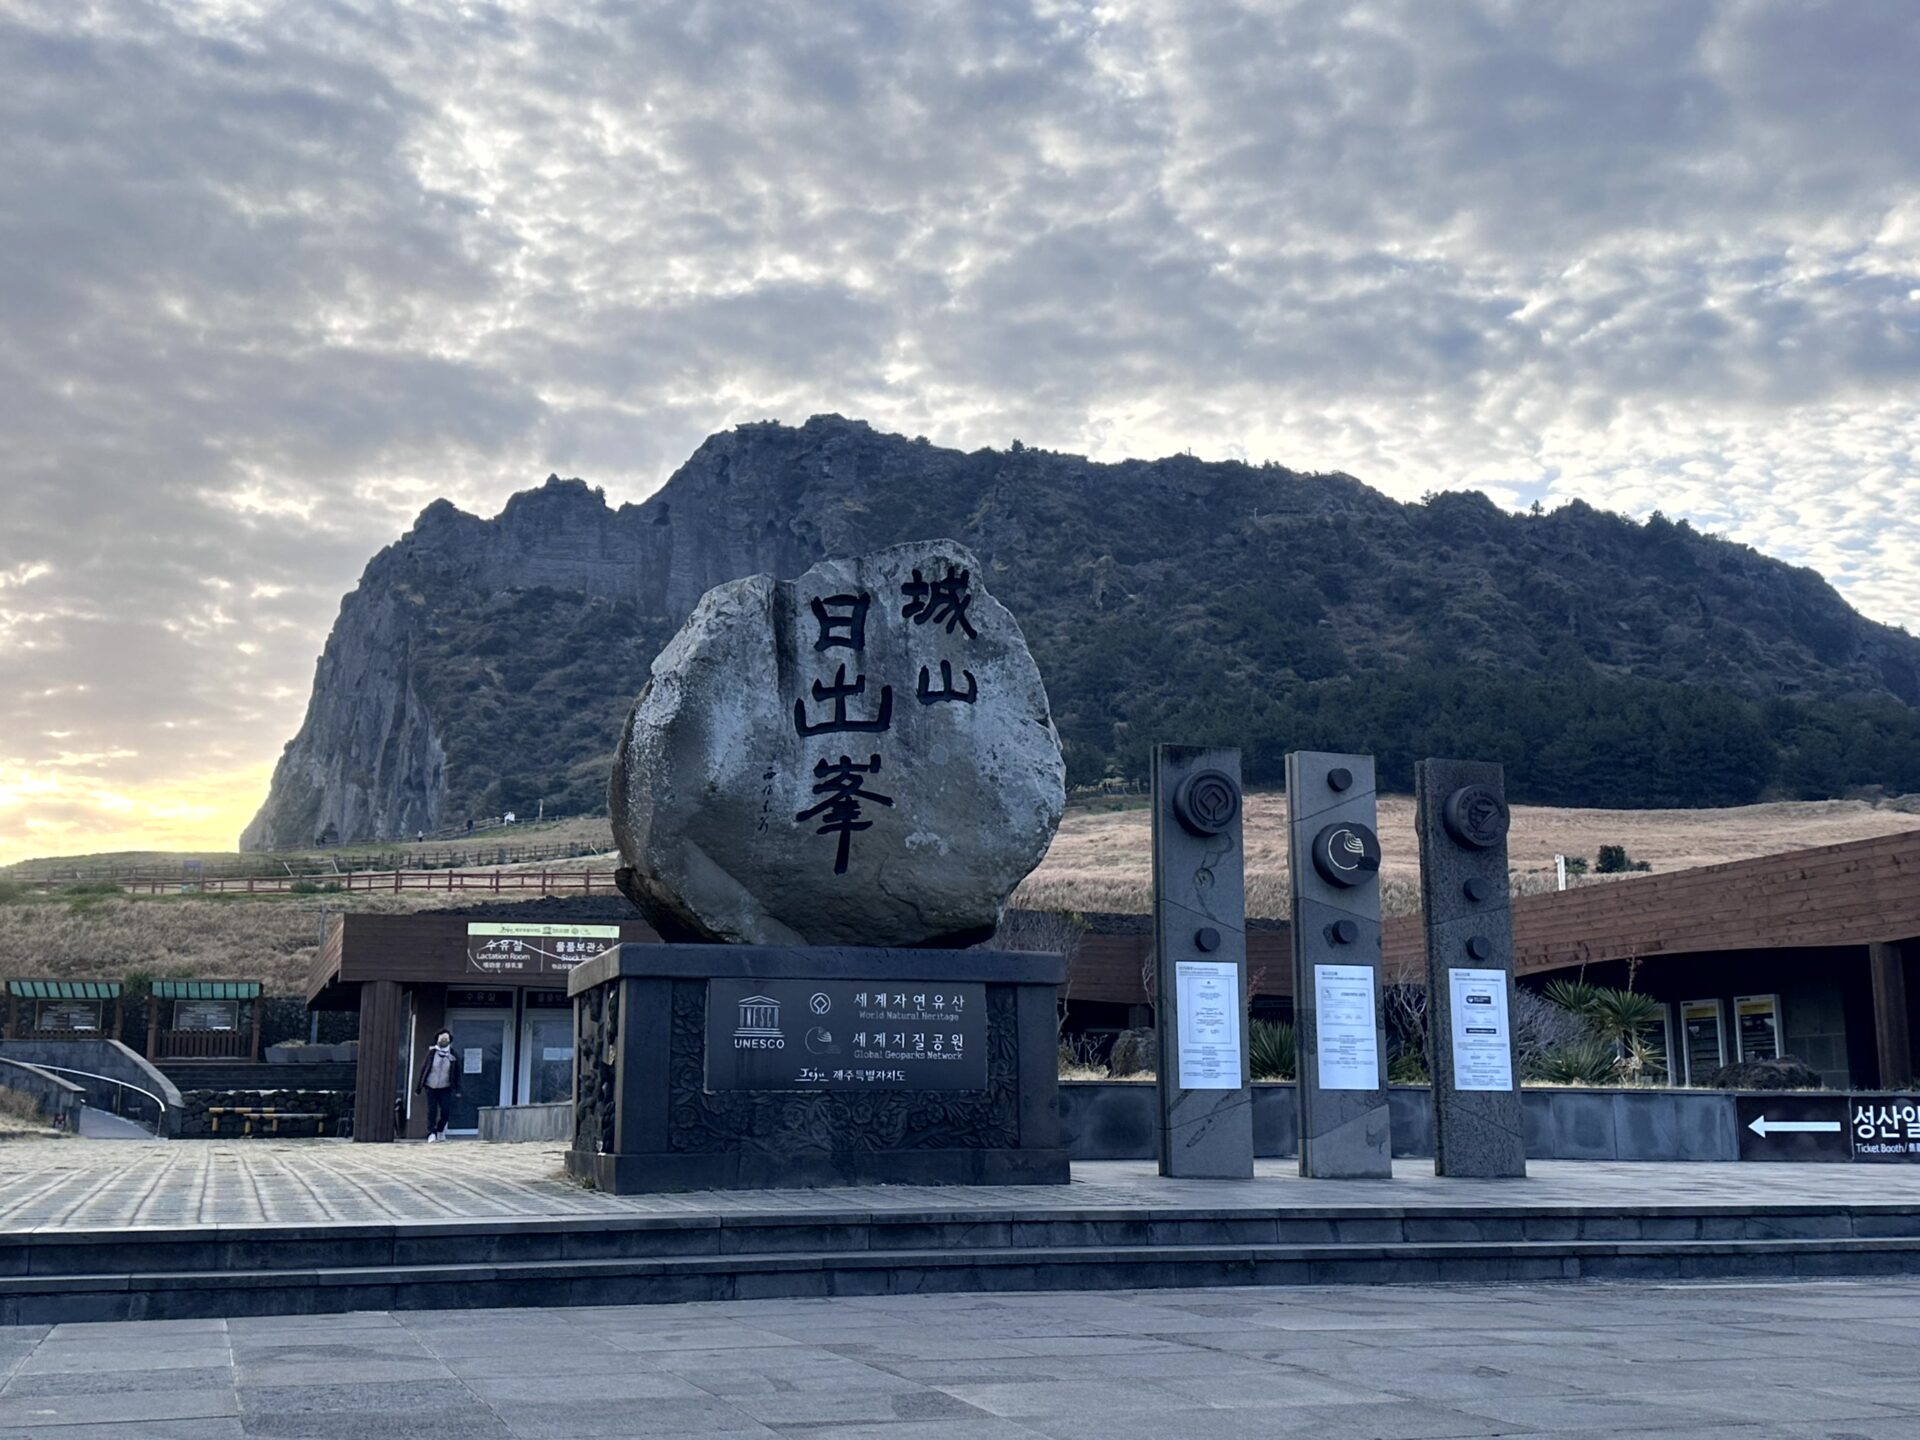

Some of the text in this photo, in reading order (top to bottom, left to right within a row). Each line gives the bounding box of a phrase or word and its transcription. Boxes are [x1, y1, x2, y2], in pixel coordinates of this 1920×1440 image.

[900, 566, 978, 705] 城山
[476, 952, 531, 960] Lactation Room
[858, 1010, 960, 1022] World Natural Heritage
[734, 1039, 785, 1049] UNESCO
[853, 1050, 963, 1061] Global Geoparks Network
[797, 1067, 826, 1082] Jeju
[832, 1068, 906, 1082] 제주특별자치도
[1853, 1105, 1920, 1139] 성산일
[1856, 1143, 1880, 1153] Ticket
